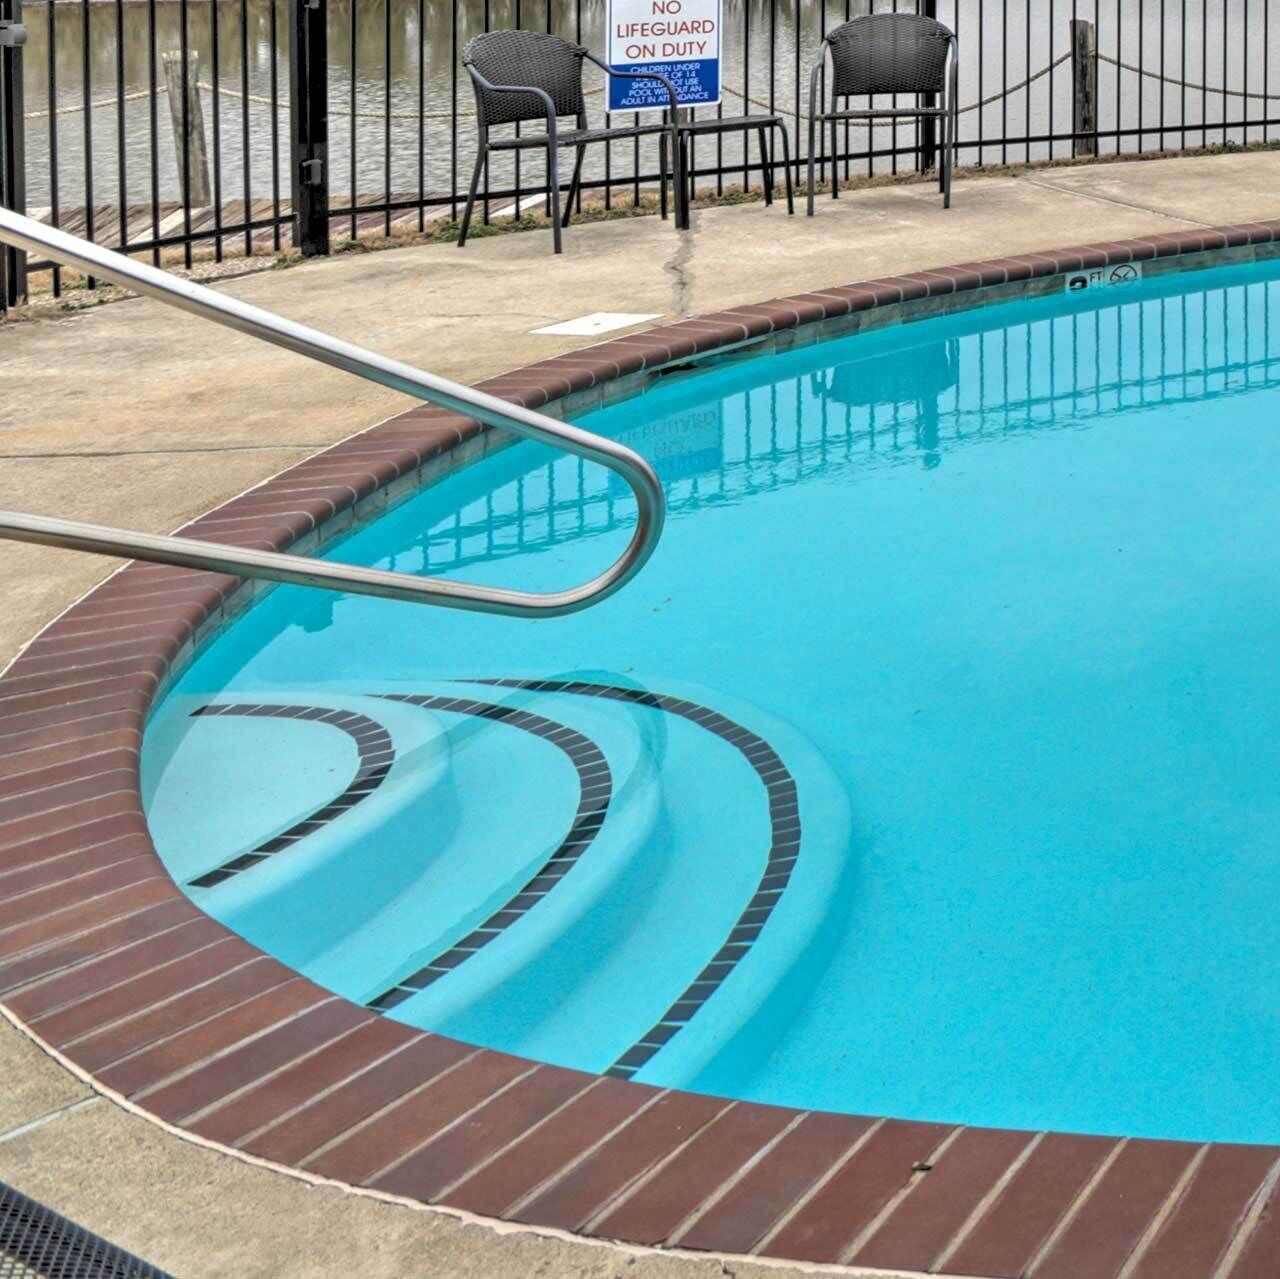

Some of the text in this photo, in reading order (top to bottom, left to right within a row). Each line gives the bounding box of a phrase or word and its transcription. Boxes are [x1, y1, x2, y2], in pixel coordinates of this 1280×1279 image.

[652, 0, 681, 15] NO
[617, 19, 715, 38] LIFEGUARD
[625, 41, 707, 59] ON DUTY
[630, 63, 700, 73] CHILDREN UNDER
[686, 70, 696, 78] 14
[628, 88, 652, 96] POOL
[689, 84, 702, 92] AN
[631, 80, 665, 89] SHOULD
[684, 78, 699, 86] USE
[620, 91, 709, 105] ADULT IN ATTNDANCE
